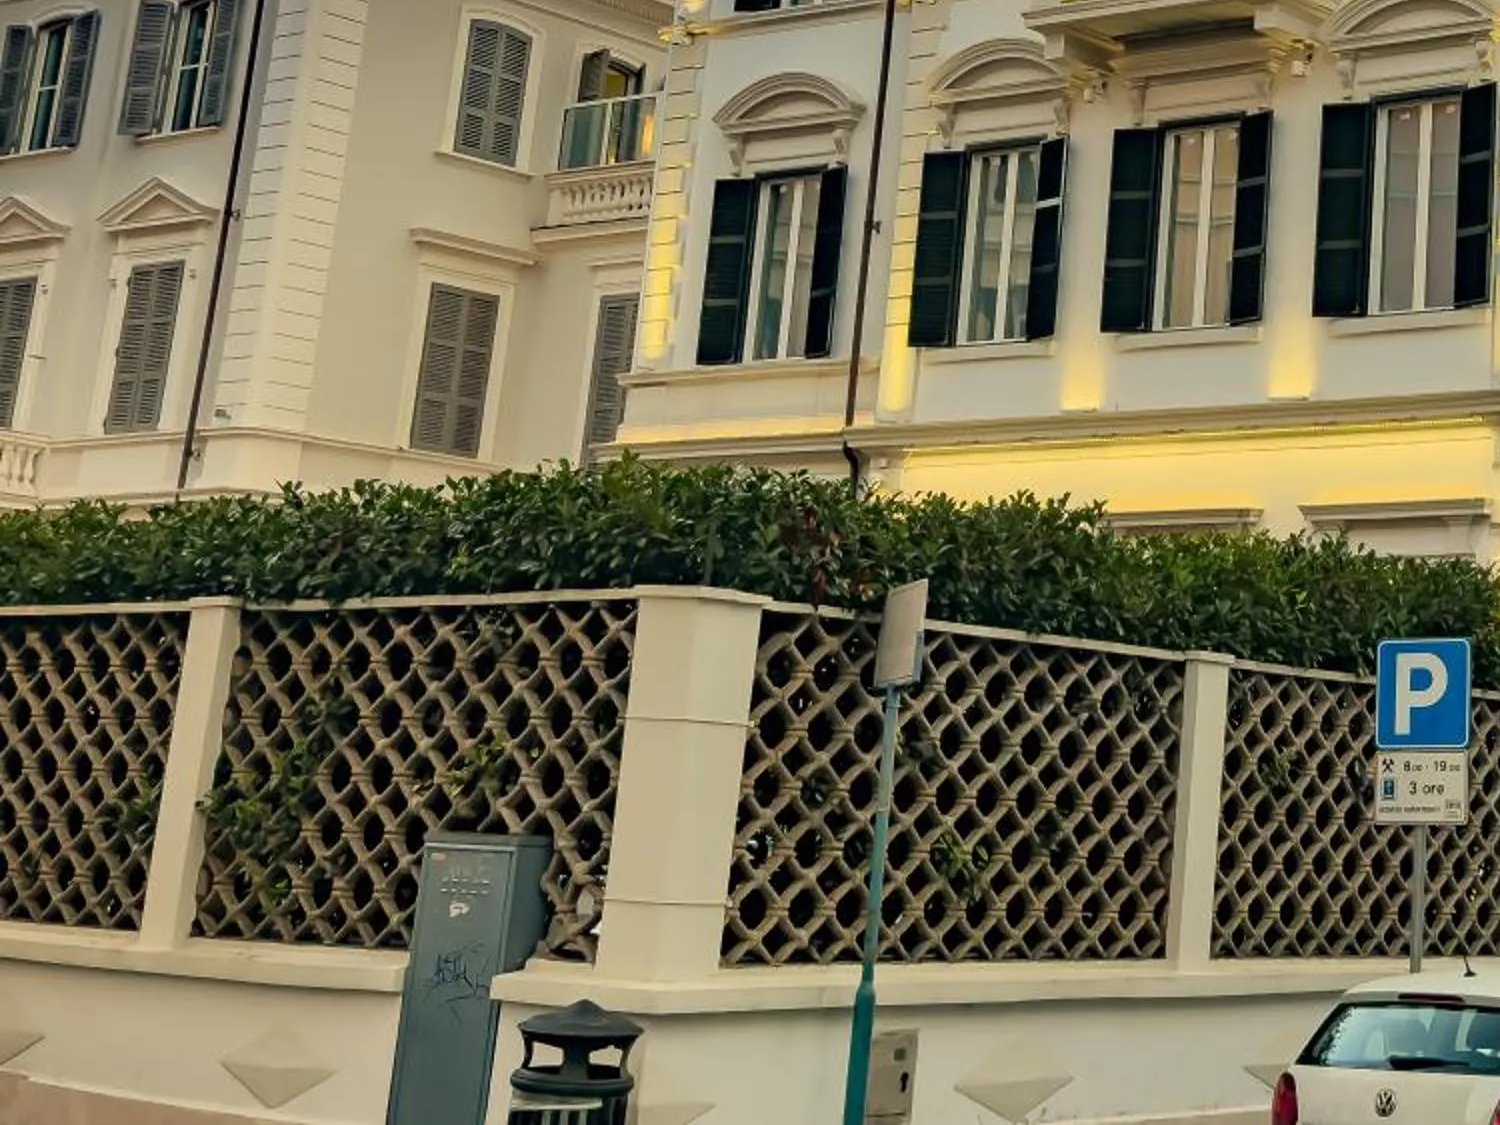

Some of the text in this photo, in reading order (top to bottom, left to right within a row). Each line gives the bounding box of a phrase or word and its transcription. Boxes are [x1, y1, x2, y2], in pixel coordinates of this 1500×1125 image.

[1394, 652, 1448, 735] P
[1409, 780, 1445, 795] 3 ore
